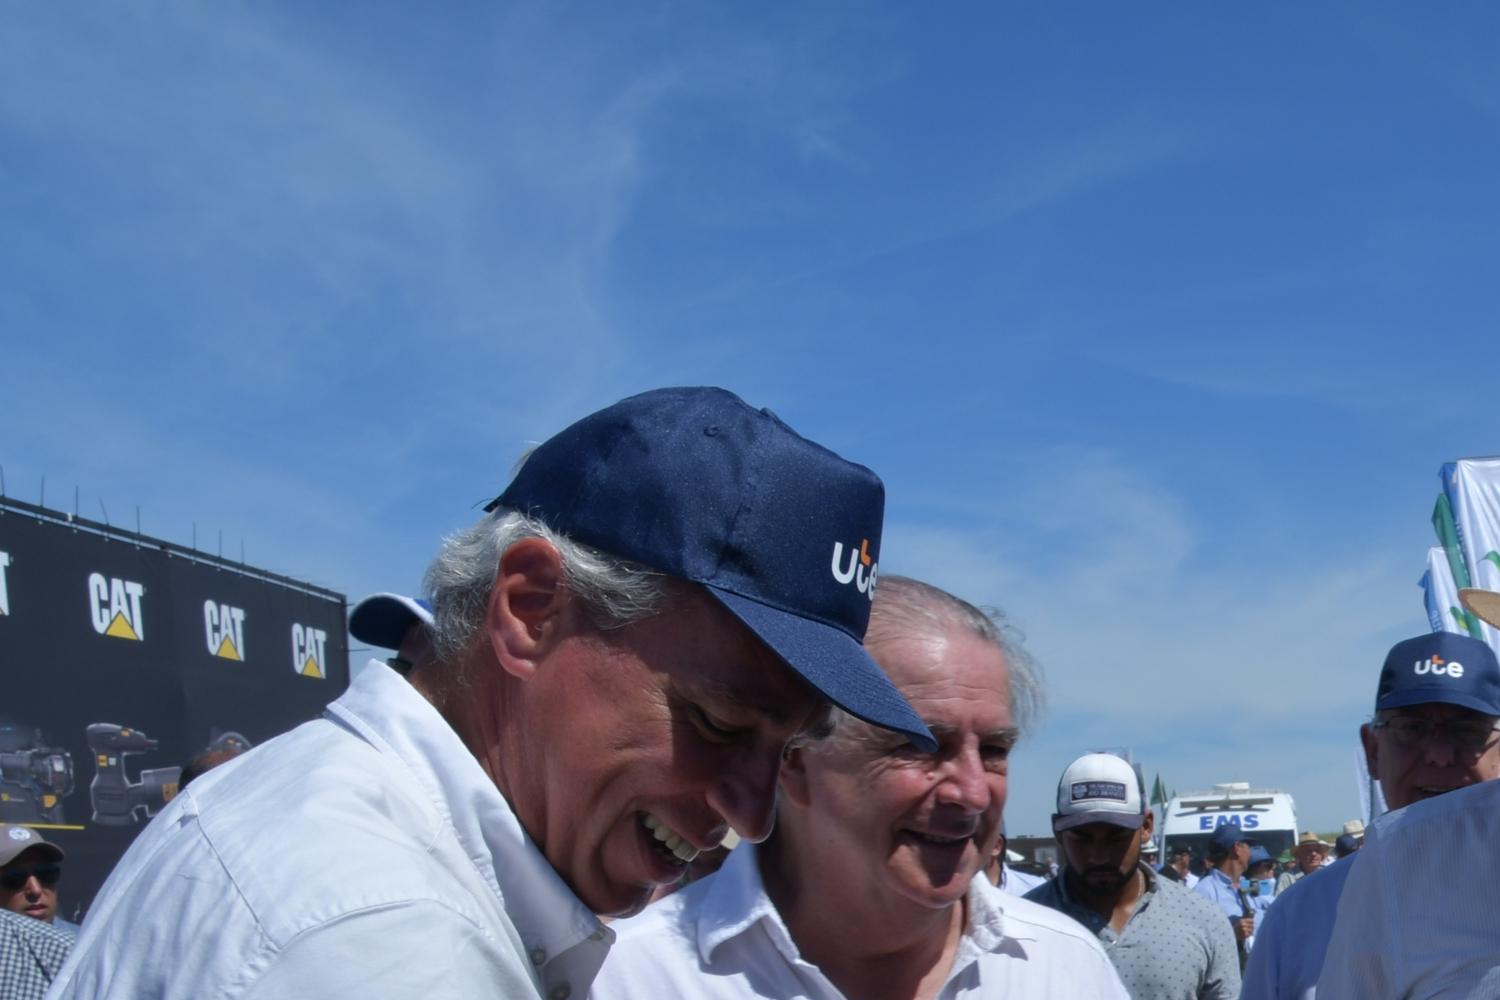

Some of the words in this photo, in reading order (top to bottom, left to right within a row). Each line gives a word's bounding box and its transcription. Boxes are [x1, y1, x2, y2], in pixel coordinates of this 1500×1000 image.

[88, 572, 144, 641] CAT
[203, 600, 245, 662] CAT
[291, 622, 327, 679] CAT
[1414, 654, 1464, 678] ute
[1199, 814, 1260, 831] EMS
